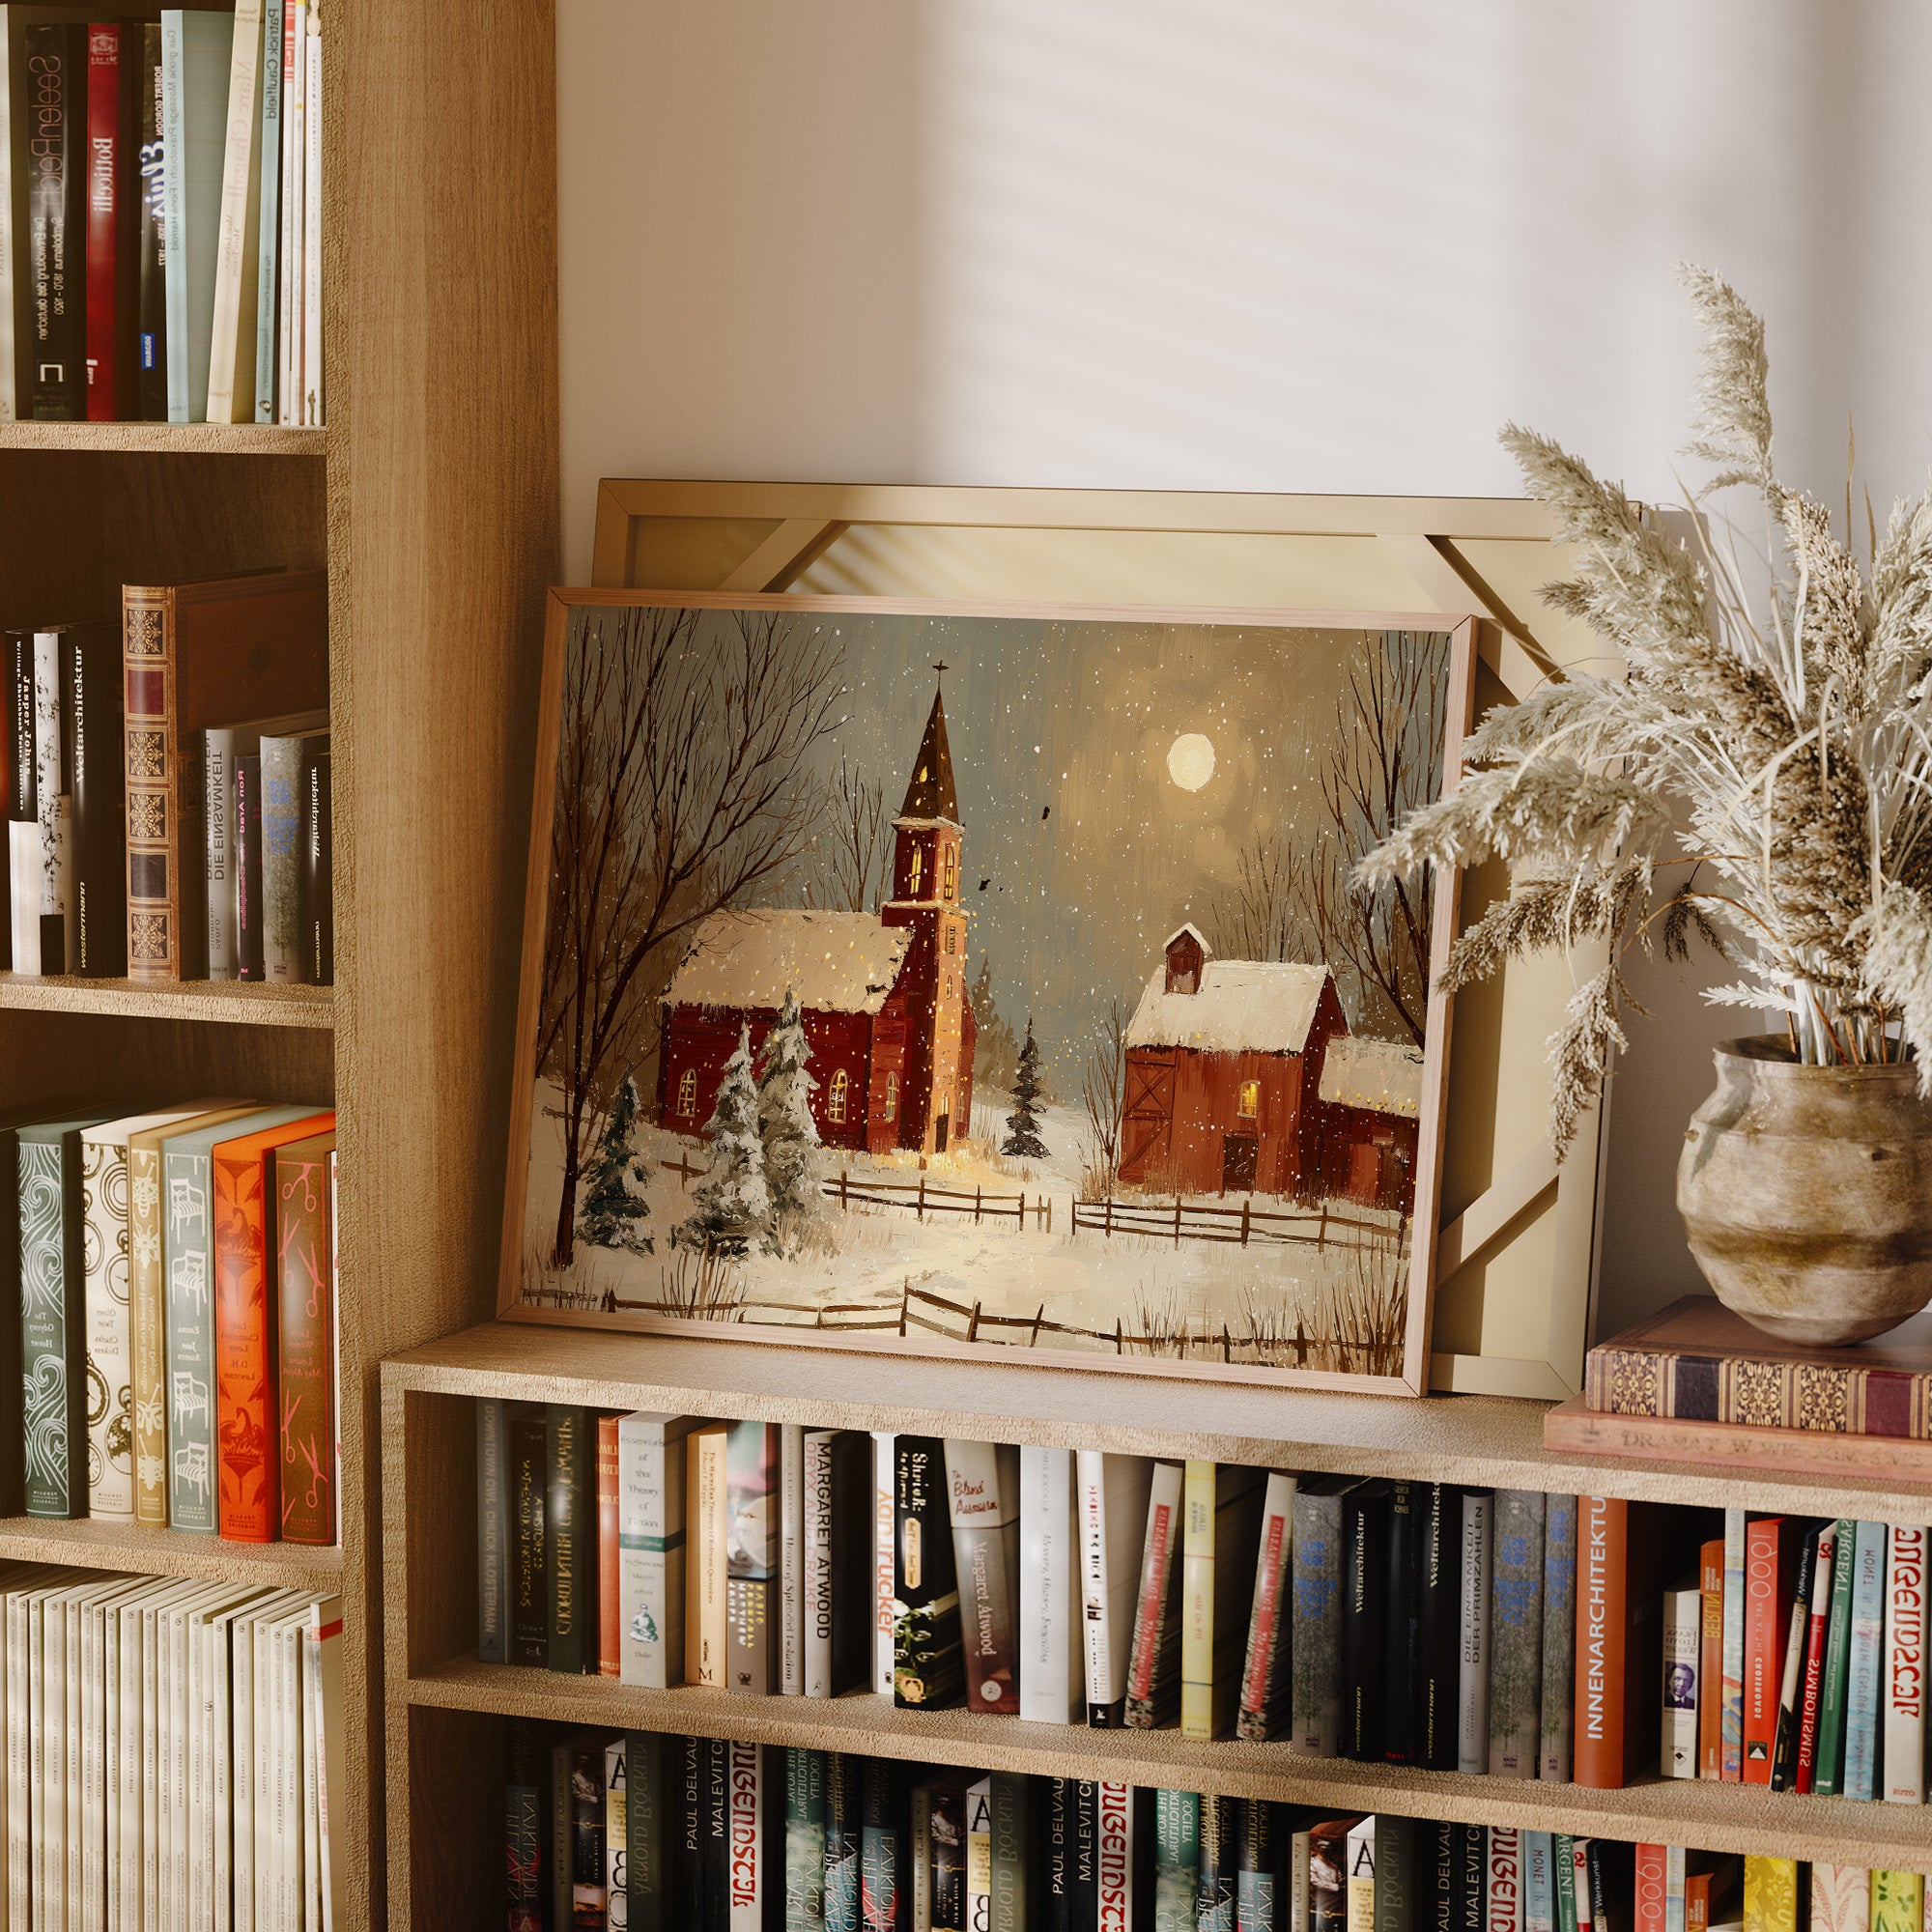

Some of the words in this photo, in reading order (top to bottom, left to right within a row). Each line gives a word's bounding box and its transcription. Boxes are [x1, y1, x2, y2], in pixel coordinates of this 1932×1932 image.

[23, 675, 32, 725] Jasper
[73, 645, 84, 784] Weltarchitektur
[23, 730, 32, 776] Johns
[78, 881, 87, 969] westermann
[806, 1440, 818, 1492] ORYX
[816, 1441, 832, 1551] MARGARET
[805, 1545, 817, 1612] CRAKE
[972, 1541, 988, 1601] Margaret
[1354, 1511, 1365, 1614] Weltarchitektur
[1472, 1506, 1484, 1622] PRIMZAHLEN
[816, 1557, 832, 1640] ATWOOD
[977, 1605, 997, 1657] Atwood
[1471, 1628, 1482, 1664] DER
[1427, 1678, 1435, 1759] westermann
[686, 1808, 697, 1851] PAUL
[1051, 1850, 1065, 1894] PAUL
[1532, 1849, 1545, 1886] MONET
[1558, 1834, 1574, 1898] ARGENT
[1591, 1860, 1604, 1908] Werkkunst
[1637, 1855, 1663, 1919] 1900
